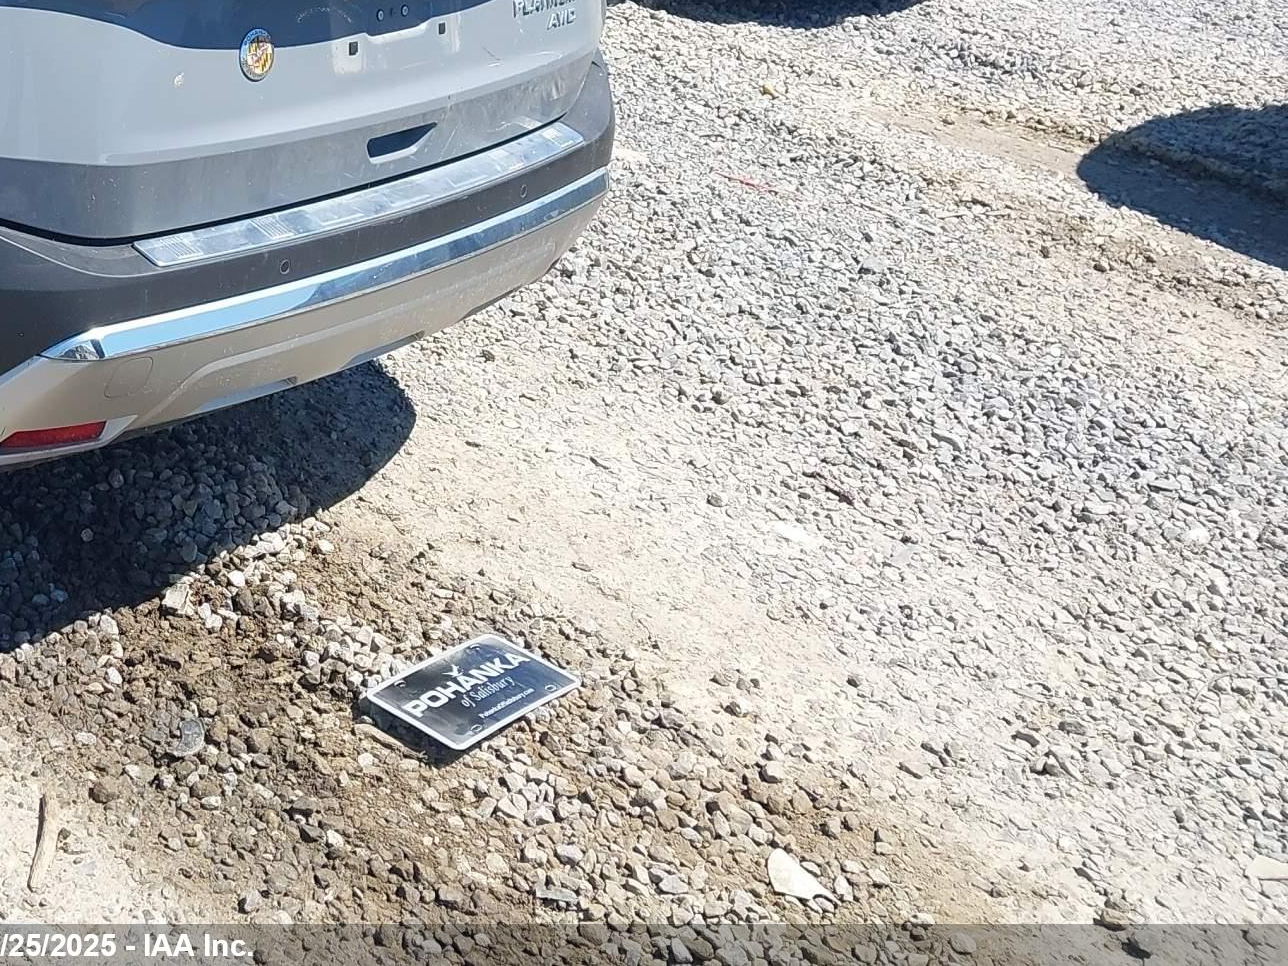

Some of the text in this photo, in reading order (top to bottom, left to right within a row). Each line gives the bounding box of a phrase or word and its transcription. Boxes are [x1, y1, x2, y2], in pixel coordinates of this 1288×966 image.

[404, 652, 532, 718] POHANKA
[461, 676, 516, 708] of Salisbury
